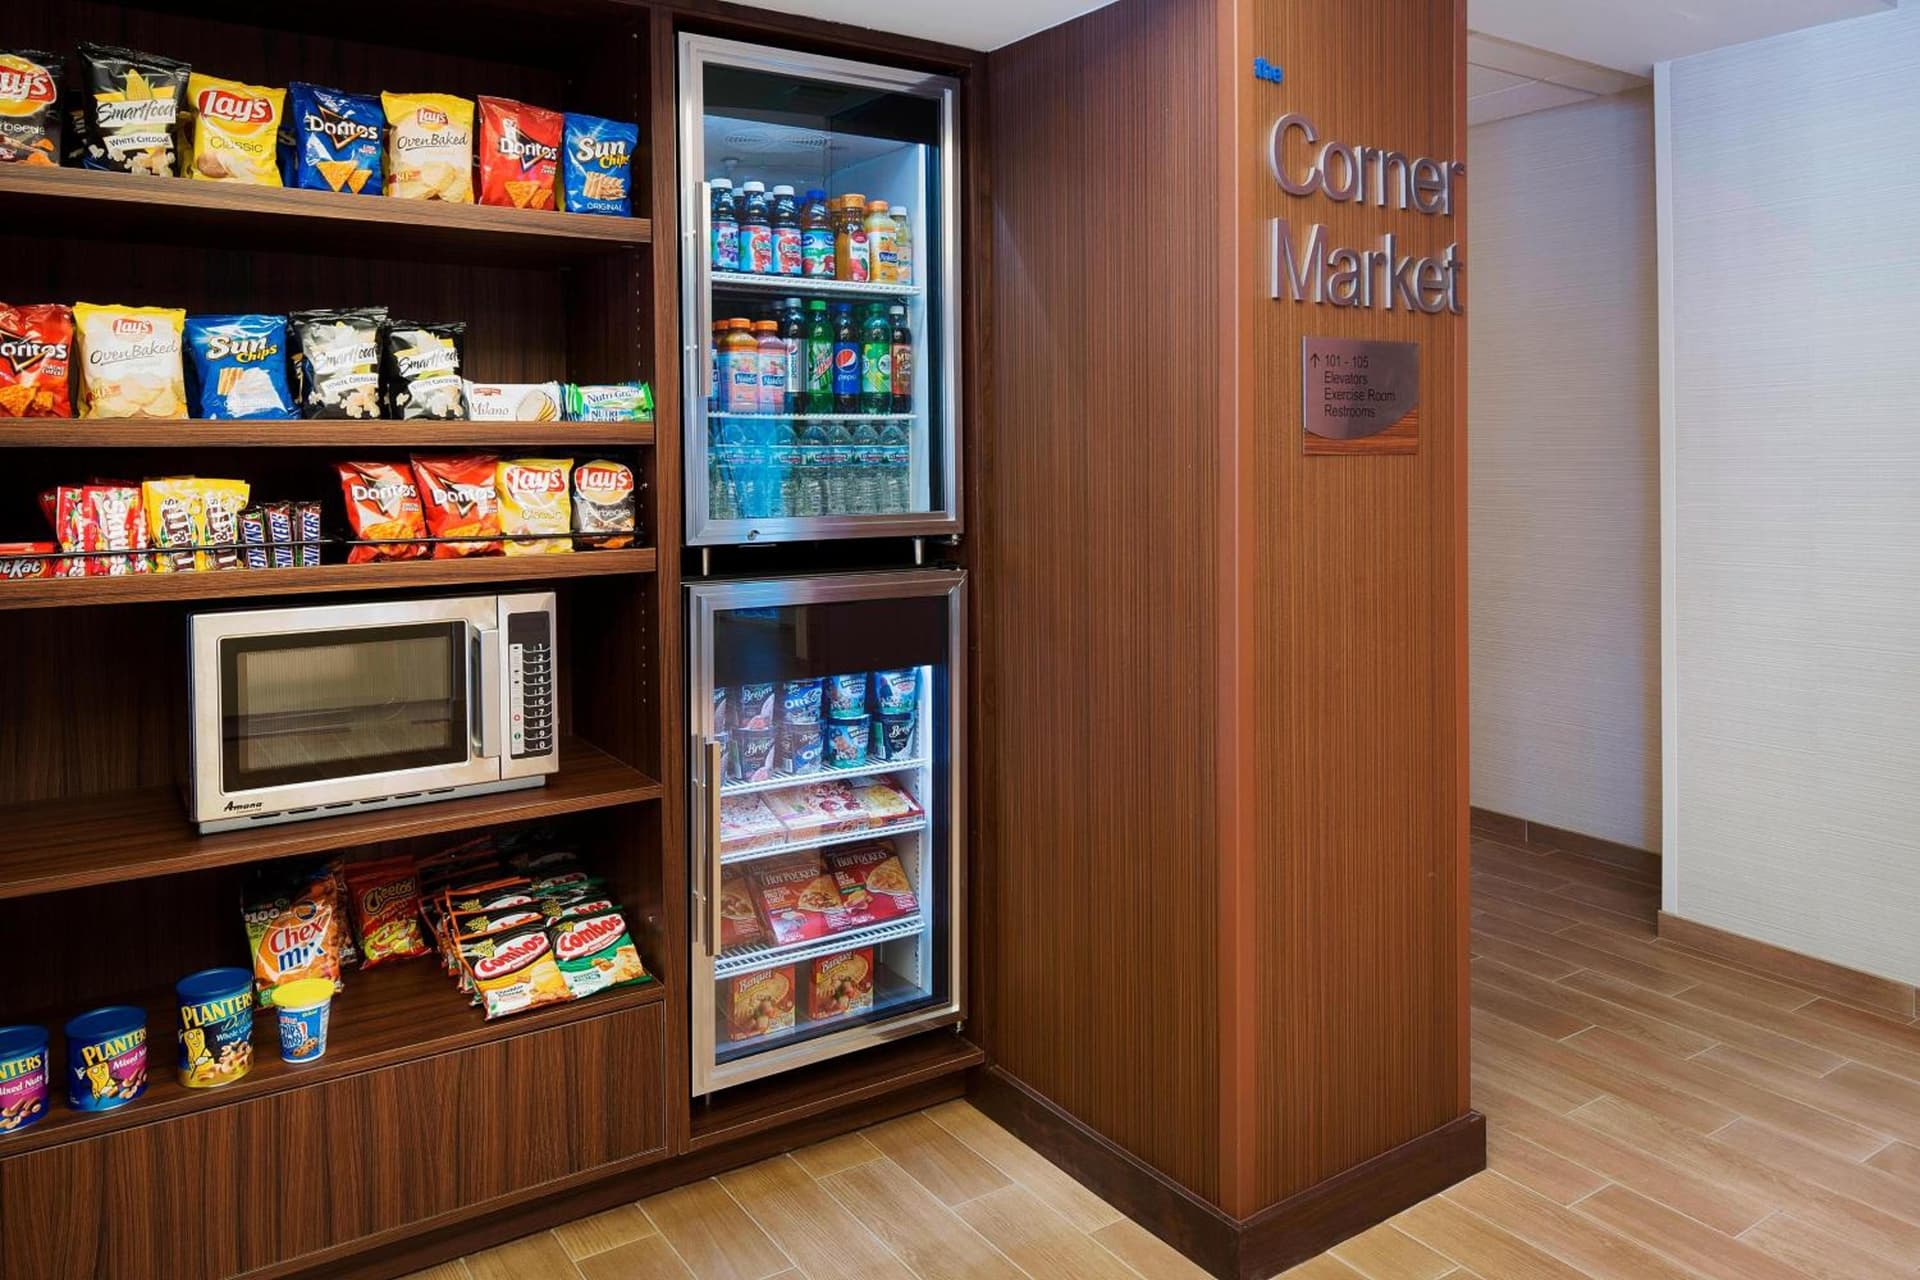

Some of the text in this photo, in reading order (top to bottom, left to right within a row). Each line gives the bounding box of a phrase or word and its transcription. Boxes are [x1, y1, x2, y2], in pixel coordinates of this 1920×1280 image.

[203, 91, 268, 122] Lay's
[308, 113, 379, 140] Doritos
[396, 131, 468, 150] Oven Baked
[499, 136, 558, 161] Doritos
[575, 137, 626, 162] Sun
[1269, 112, 1466, 217] Corner
[1270, 216, 1465, 315] Market
[205, 335, 278, 363] Sun Chips
[1324, 370, 1370, 386] Elevators
[1324, 387, 1397, 402] Exercise Room
[471, 402, 509, 416] Milano
[1324, 404, 1377, 419] Restrooms
[514, 468, 561, 493] Lay's
[581, 468, 628, 491] Lay's
[353, 485, 417, 501] Doritos
[223, 800, 263, 812] Amana
[270, 916, 323, 953] Chex
[560, 916, 622, 952] Combos
[479, 935, 545, 972] Combos
